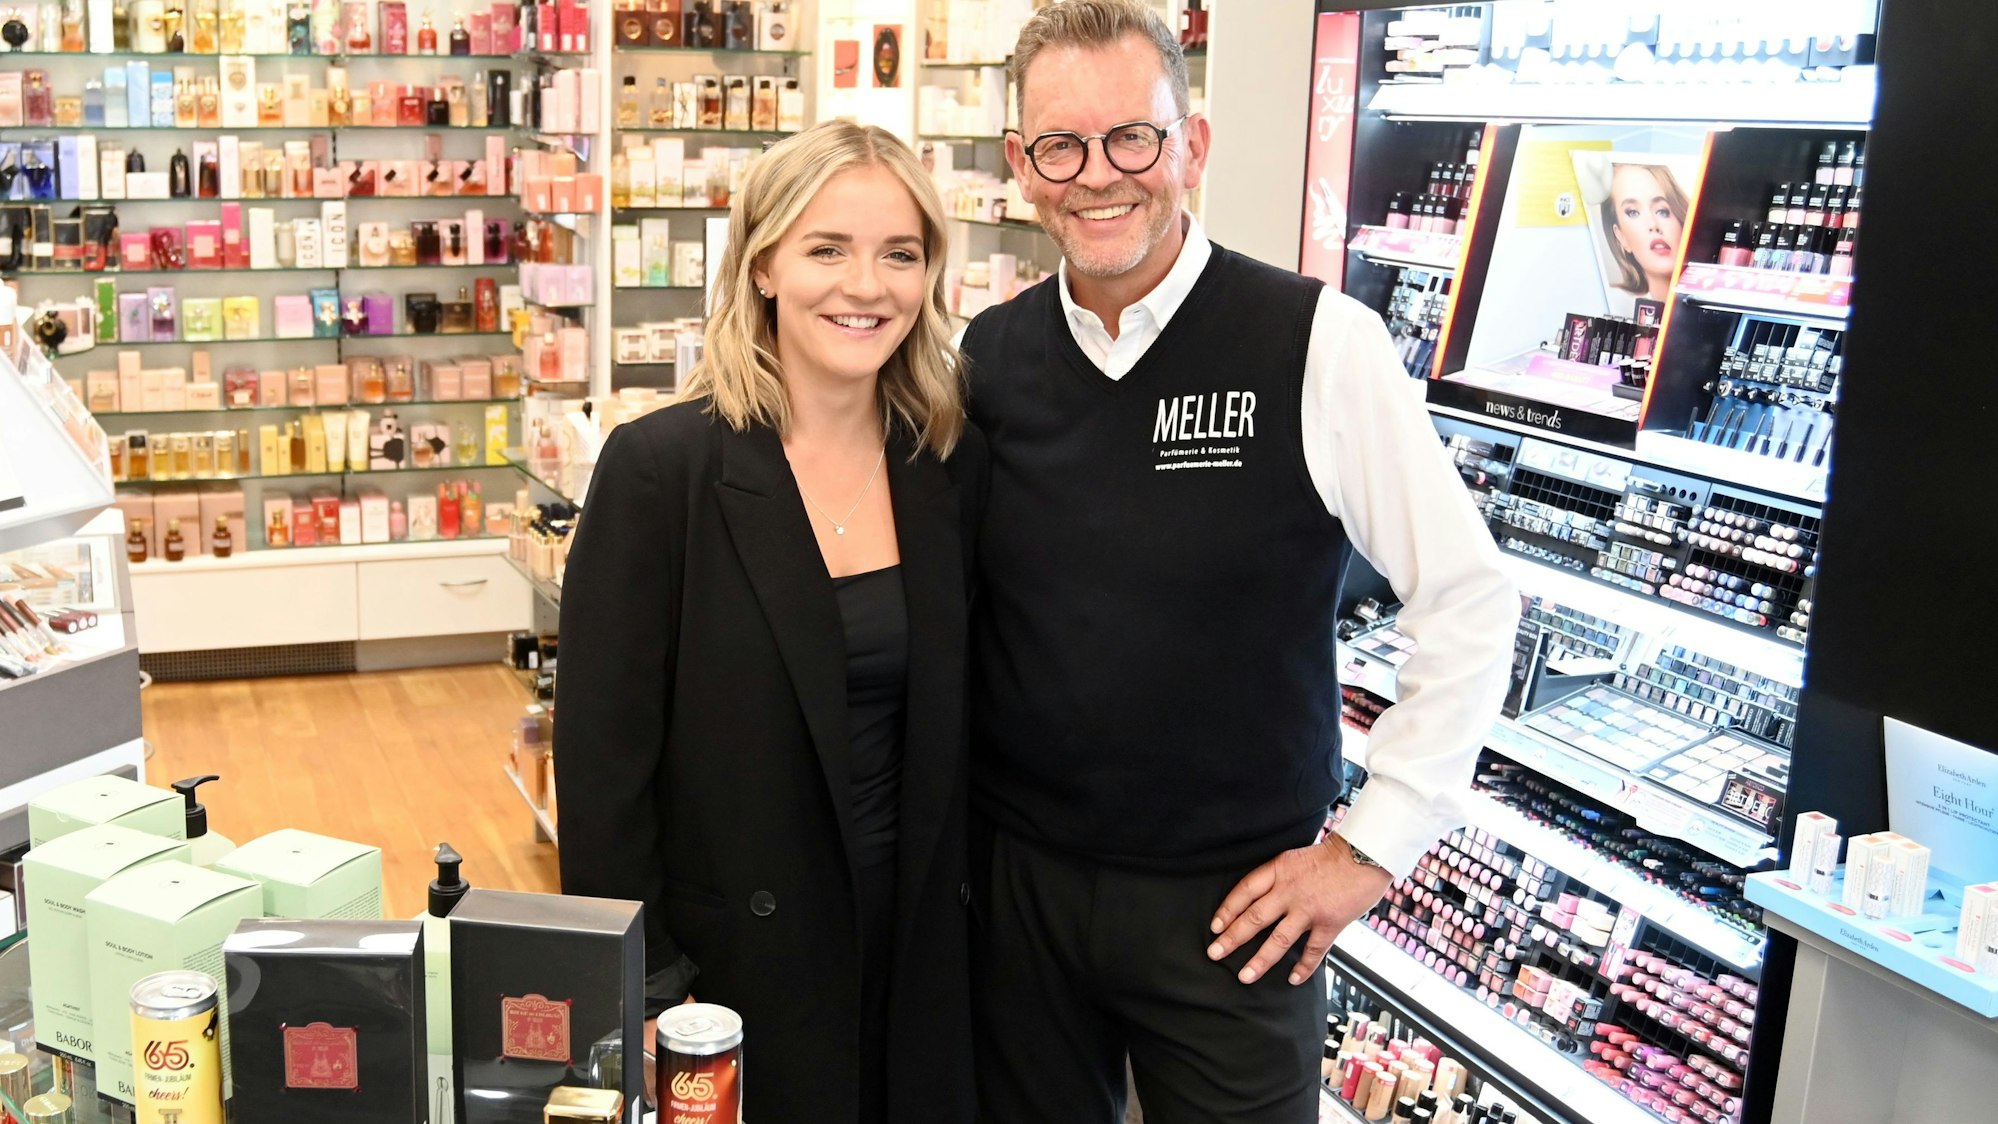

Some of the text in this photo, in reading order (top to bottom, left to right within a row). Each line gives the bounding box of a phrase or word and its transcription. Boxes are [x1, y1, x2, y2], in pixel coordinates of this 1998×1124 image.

[1152, 390, 1257, 443] MELLER
[1485, 401, 1562, 429] news & trends
[1160, 446, 1240, 457] Parfümerie & Kosmetik
[1933, 785, 1994, 819] Eight Hour
[56, 1031, 93, 1053] BABOR
